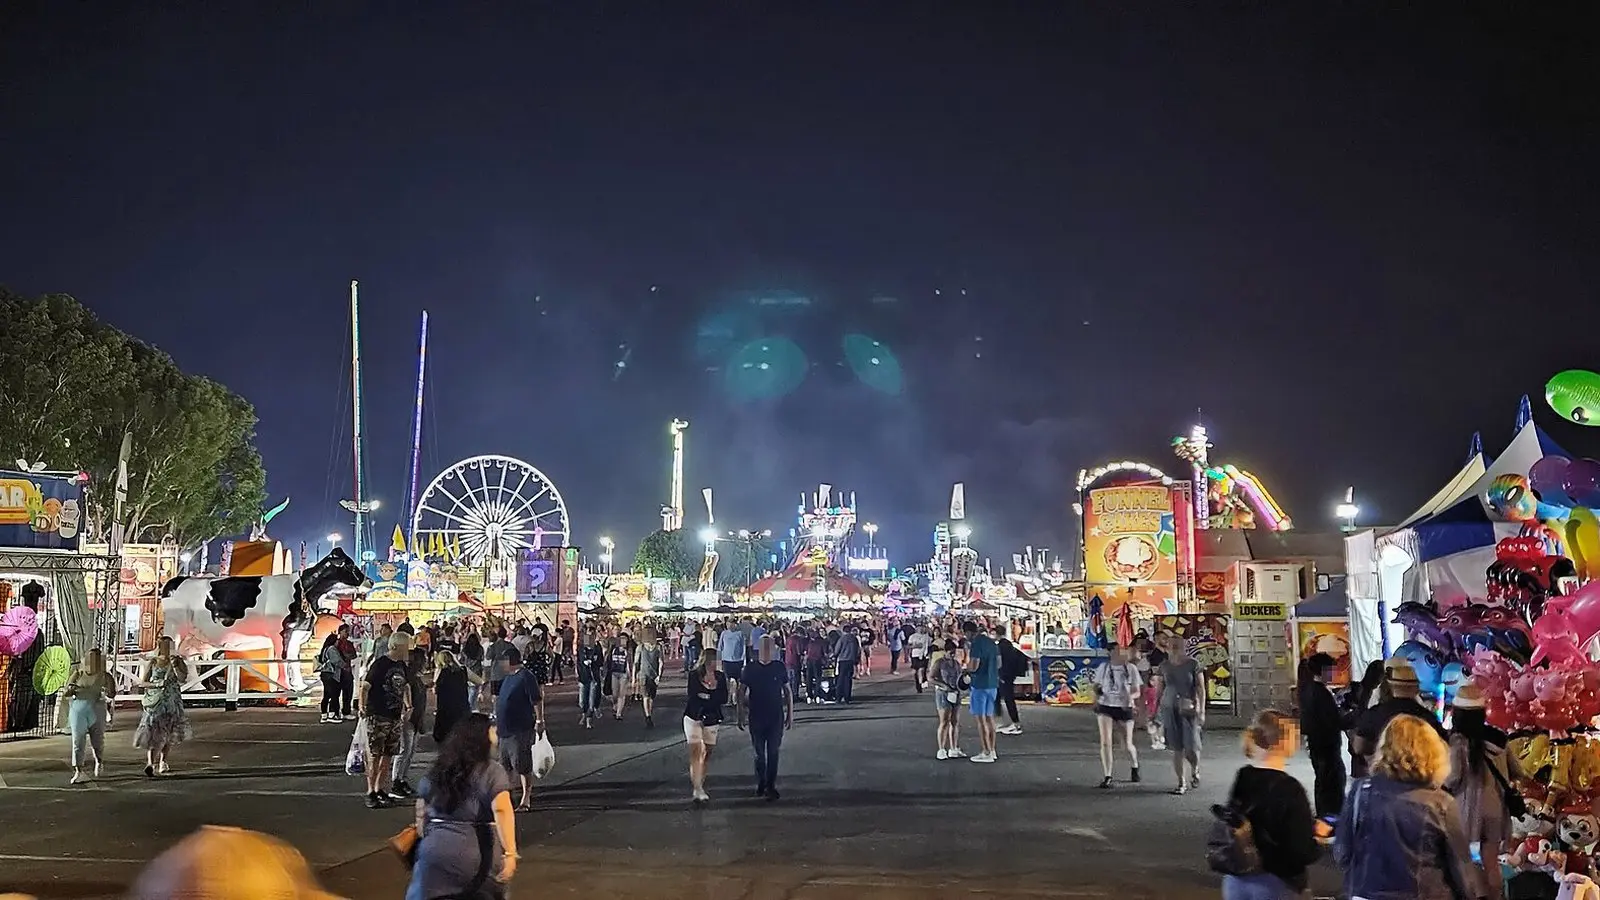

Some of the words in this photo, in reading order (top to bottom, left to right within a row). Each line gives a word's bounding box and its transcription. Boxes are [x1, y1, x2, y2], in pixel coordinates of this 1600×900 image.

[1090, 486, 1170, 514] FUNNEL
[1099, 512, 1161, 534] CAKES
[1239, 605, 1282, 616] LOCKERS
